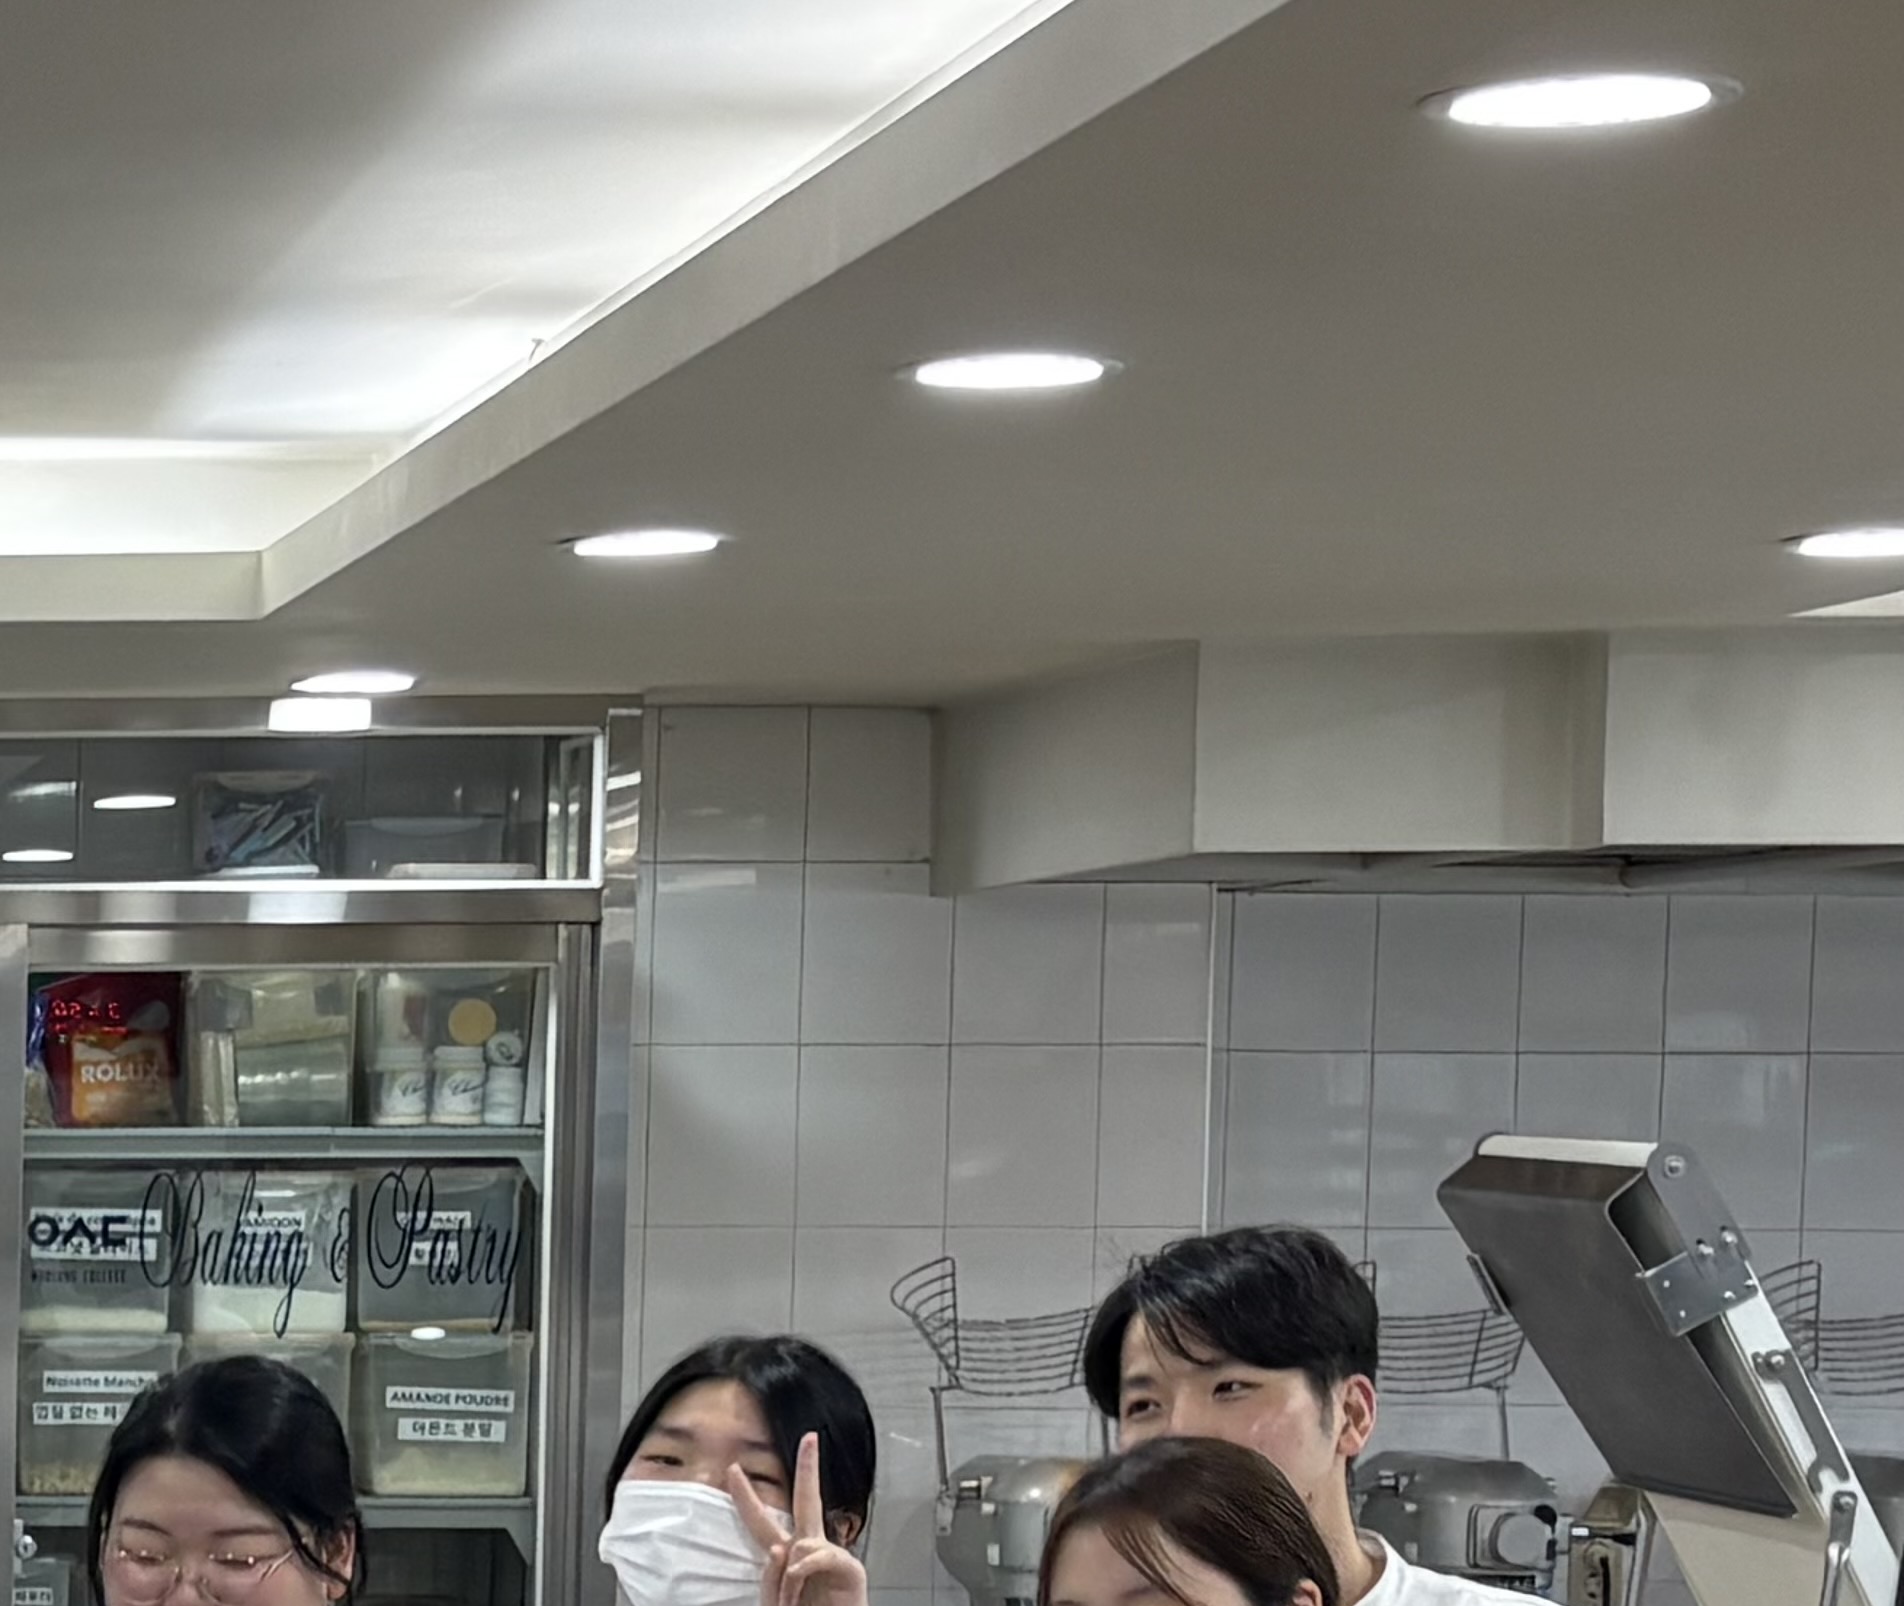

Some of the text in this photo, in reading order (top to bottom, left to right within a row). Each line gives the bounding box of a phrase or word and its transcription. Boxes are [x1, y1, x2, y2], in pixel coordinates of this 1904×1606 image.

[81, 1062, 159, 1084] ROLUX
[139, 1168, 307, 1338] Baking
[365, 1165, 523, 1334] Pastry
